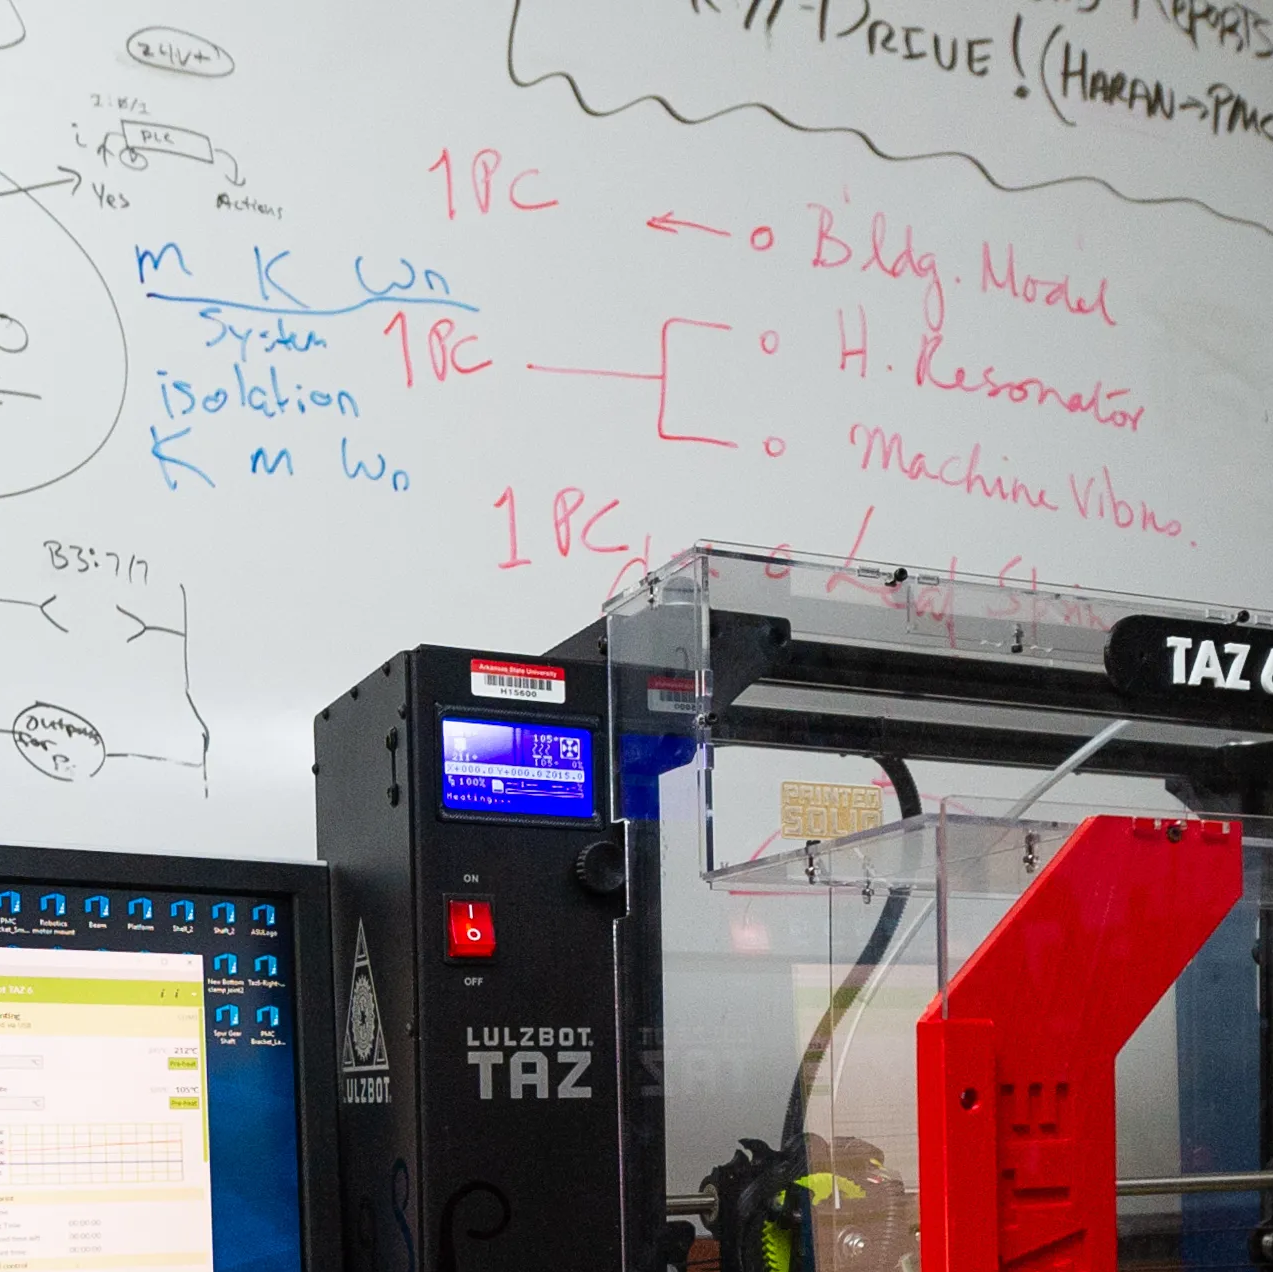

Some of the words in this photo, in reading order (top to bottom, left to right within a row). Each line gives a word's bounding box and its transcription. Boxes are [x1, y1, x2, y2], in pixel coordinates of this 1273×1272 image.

[92, 182, 130, 209] Yes
[216, 192, 284, 220] Actions
[980, 245, 1118, 327] Model
[917, 334, 1146, 433] Resonator
[850, 422, 1059, 512] Machine
[526, 668, 557, 679] University
[1166, 635, 1251, 692] TAZ
[463, 874, 479, 883] ON
[464, 976, 483, 986] OFF
[467, 1050, 593, 1100] TAZ
[342, 1076, 392, 1104] ULZBOT
